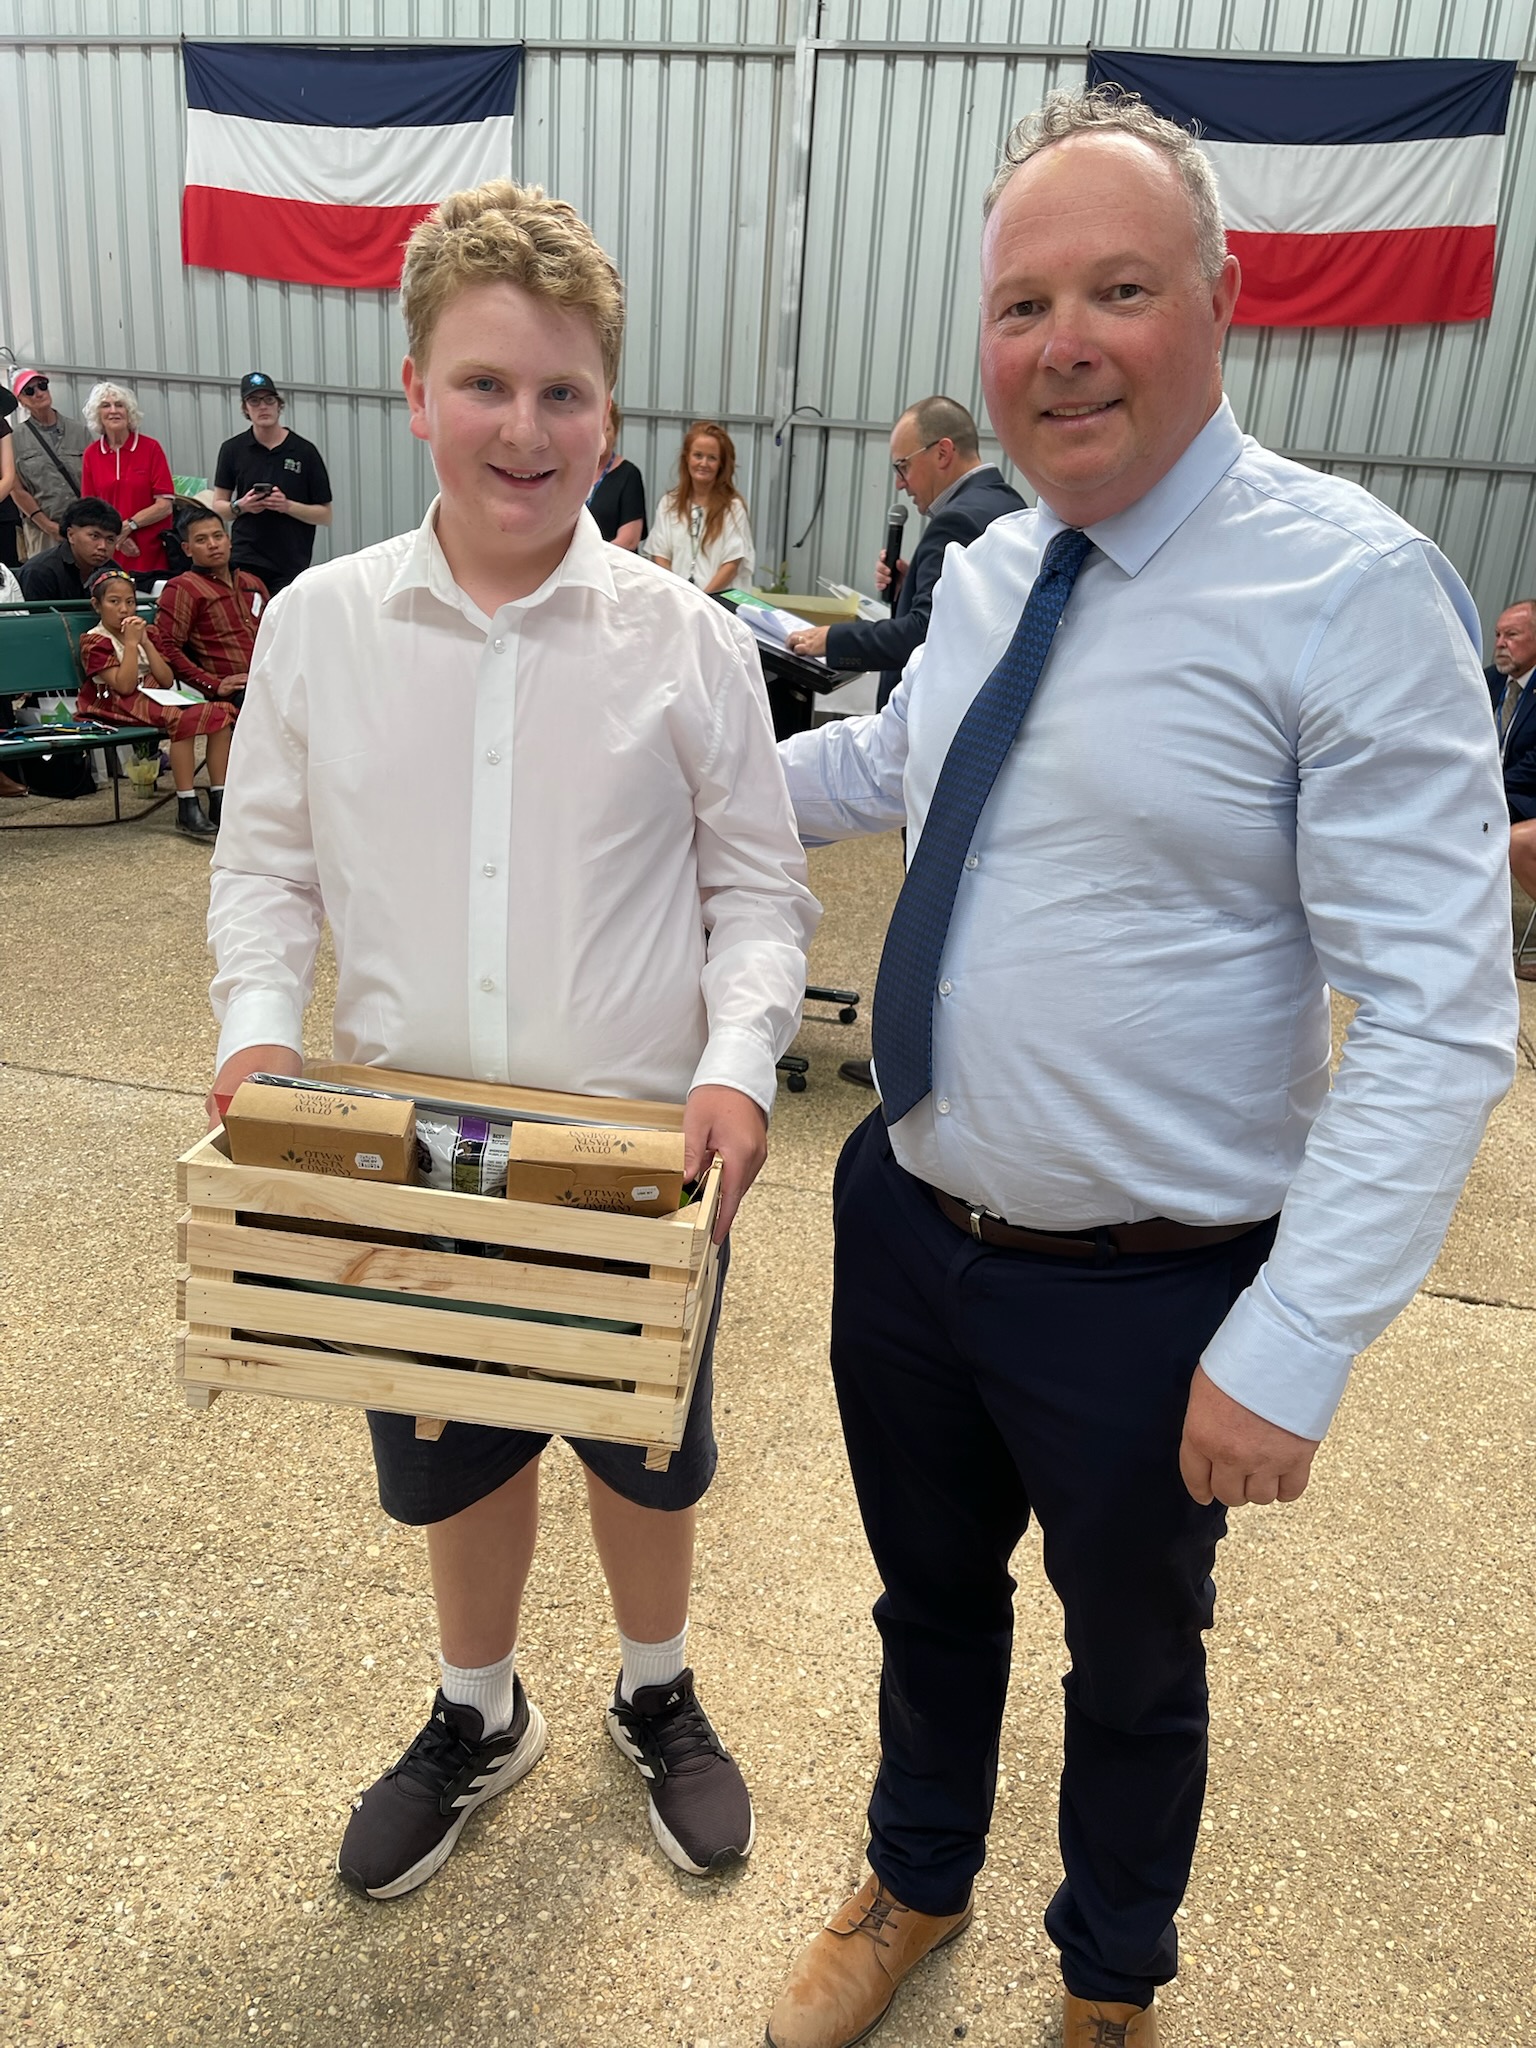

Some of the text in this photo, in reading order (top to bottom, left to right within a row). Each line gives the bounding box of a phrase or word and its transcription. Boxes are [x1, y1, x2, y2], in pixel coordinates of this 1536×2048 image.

[299, 1099, 332, 1109] PASTA
[292, 1105, 332, 1116] OTWAY
[568, 1131, 617, 1140] COMPANY
[576, 1138, 609, 1147] PASTA
[572, 1145, 611, 1154] OTWAY
[304, 1150, 346, 1162] OTWAY
[308, 1158, 343, 1169] PASTA
[300, 1164, 354, 1177] COMPANY
[583, 1189, 628, 1199] OTWAY
[585, 1196, 624, 1206] PASTA
